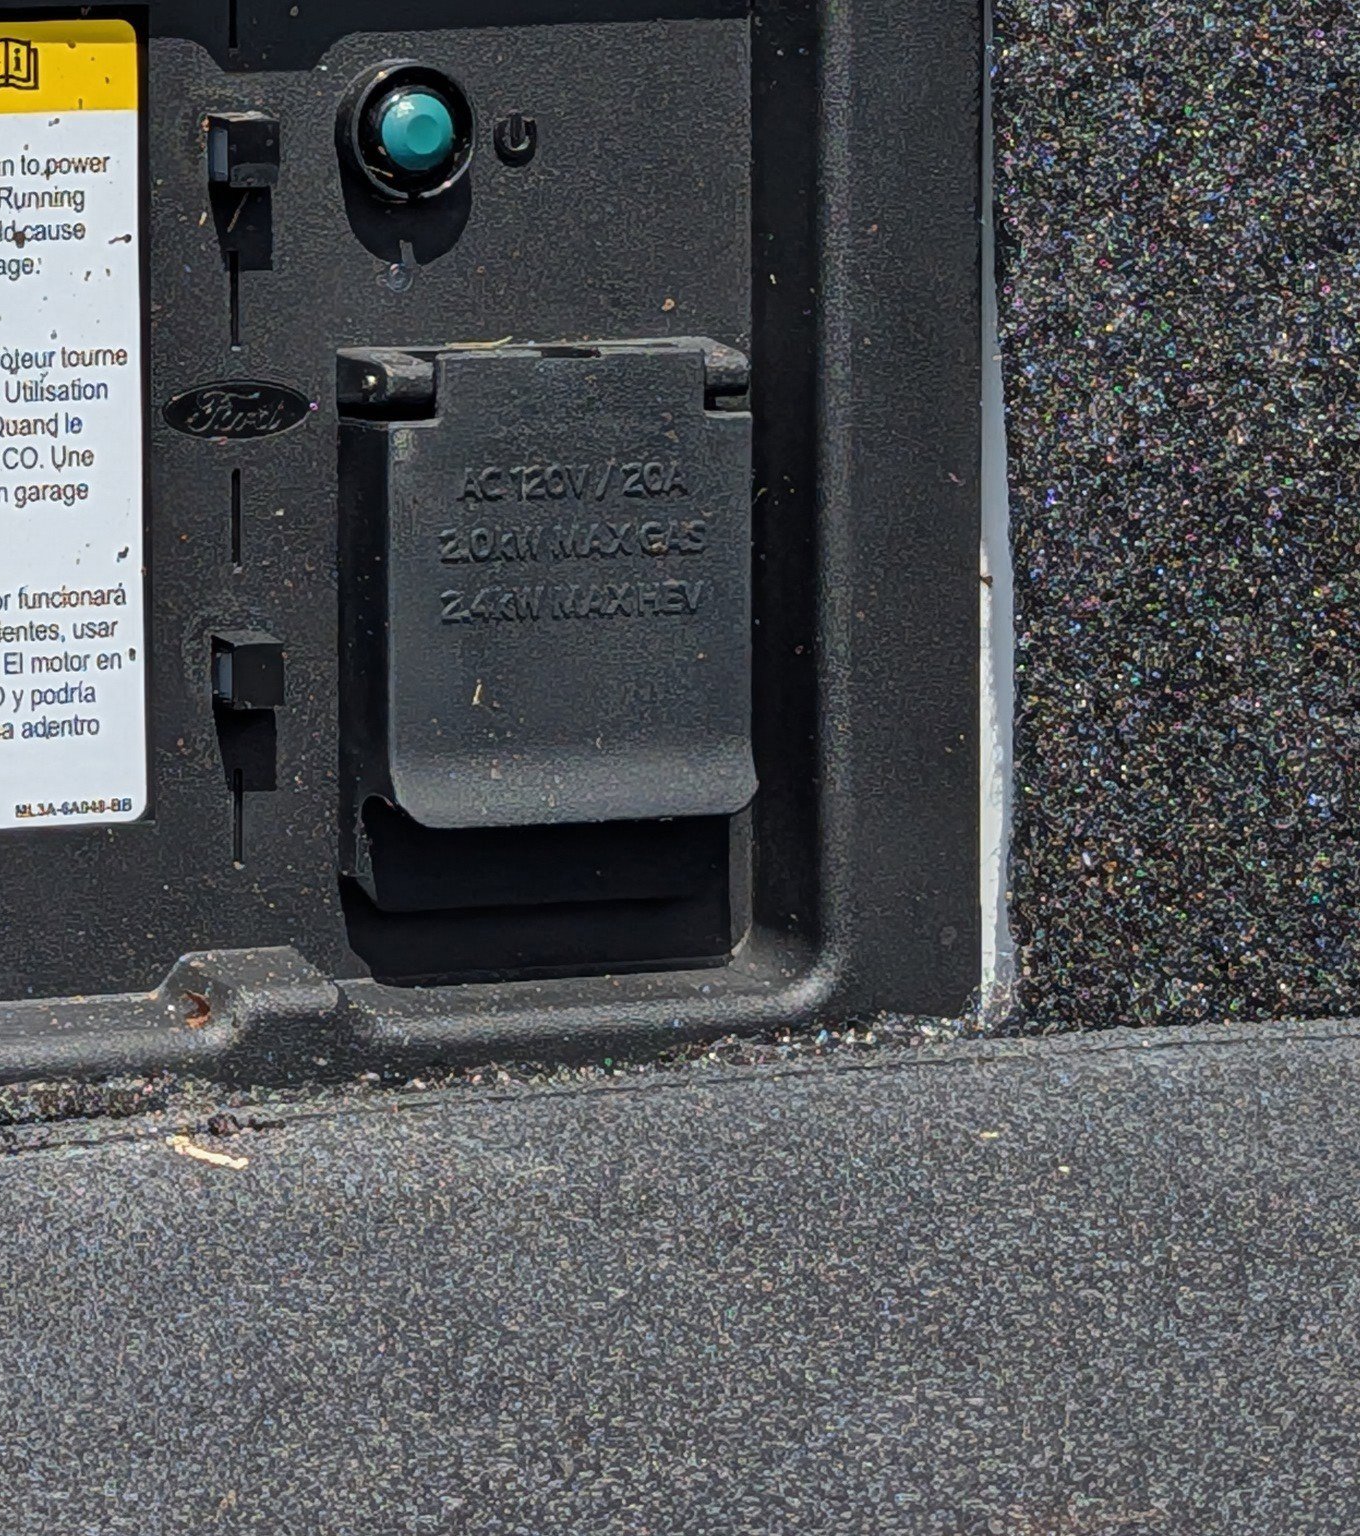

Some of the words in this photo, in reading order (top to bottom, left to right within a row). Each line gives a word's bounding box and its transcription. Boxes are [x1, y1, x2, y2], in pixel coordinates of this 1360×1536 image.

[21, 156, 40, 174] to
[44, 155, 110, 179] power
[23, 223, 85, 241] cause
[61, 346, 128, 367] tourne
[4, 380, 108, 403] Utilisation
[64, 414, 82, 434] le
[187, 391, 281, 432] Ford
[2, 447, 44, 470] CO.
[51, 446, 94, 471] Une
[14, 481, 88, 508] garage
[457, 465, 502, 502] AC
[510, 465, 584, 500] 120V
[622, 463, 689, 498] 20A
[552, 522, 631, 560] MAX
[640, 520, 708, 555] GAS
[18, 584, 126, 610] funcionará
[552, 583, 633, 620] MAX
[639, 579, 708, 616] HEV
[72, 620, 117, 639] usar
[4, 652, 22, 674] El
[31, 652, 88, 673] motor
[96, 651, 122, 670] en
[12, 688, 24, 713] y
[30, 682, 96, 707] podría
[21, 714, 99, 739] adentro
